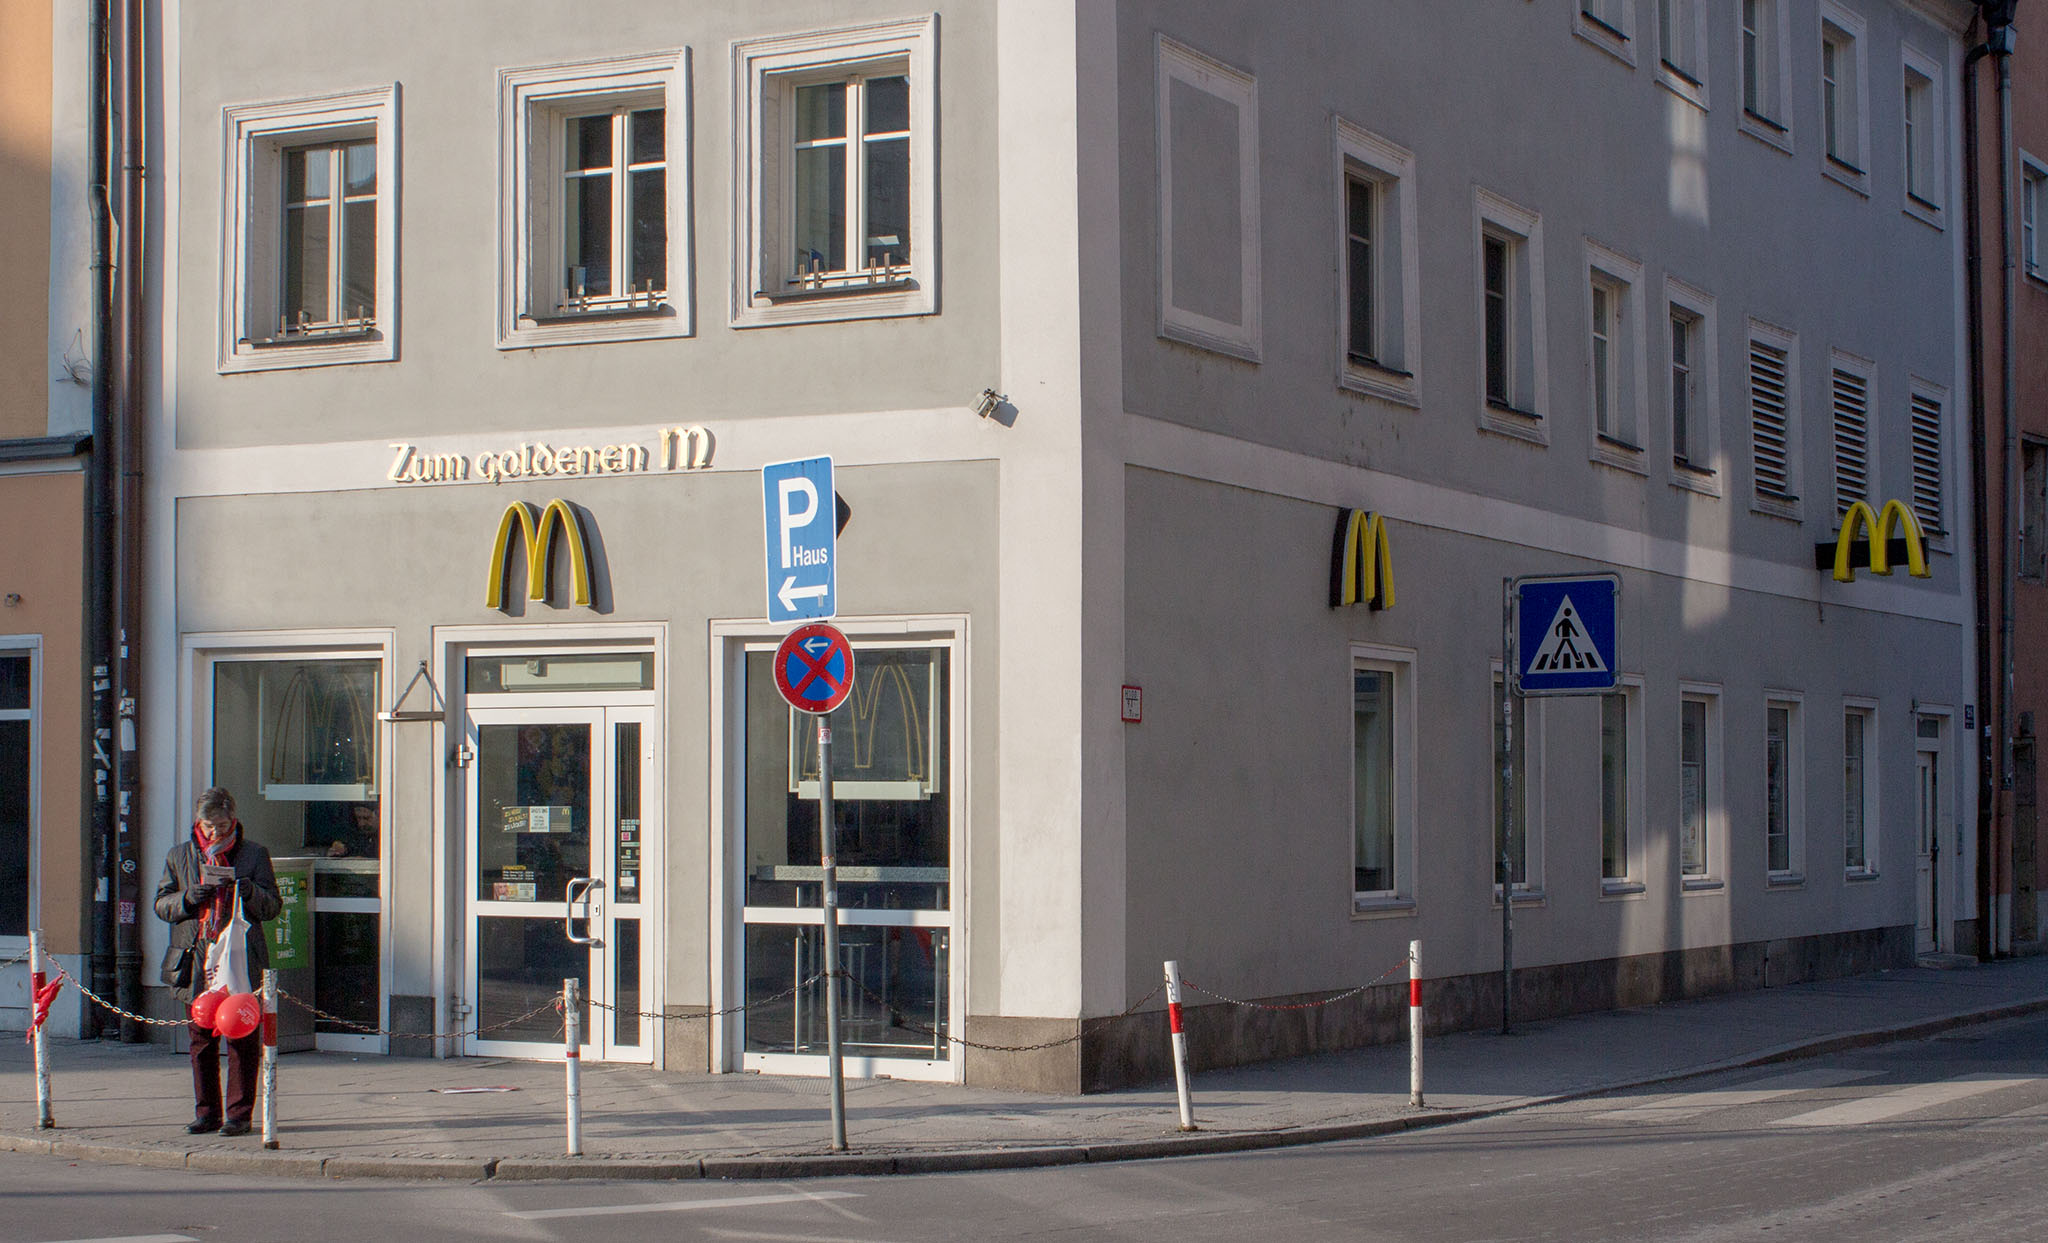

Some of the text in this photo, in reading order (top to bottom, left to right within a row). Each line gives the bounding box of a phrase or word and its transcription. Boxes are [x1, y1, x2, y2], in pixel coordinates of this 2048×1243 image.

[386, 424, 712, 484] Zum goldenen M
[778, 476, 819, 569] P
[792, 545, 829, 567] Haus
